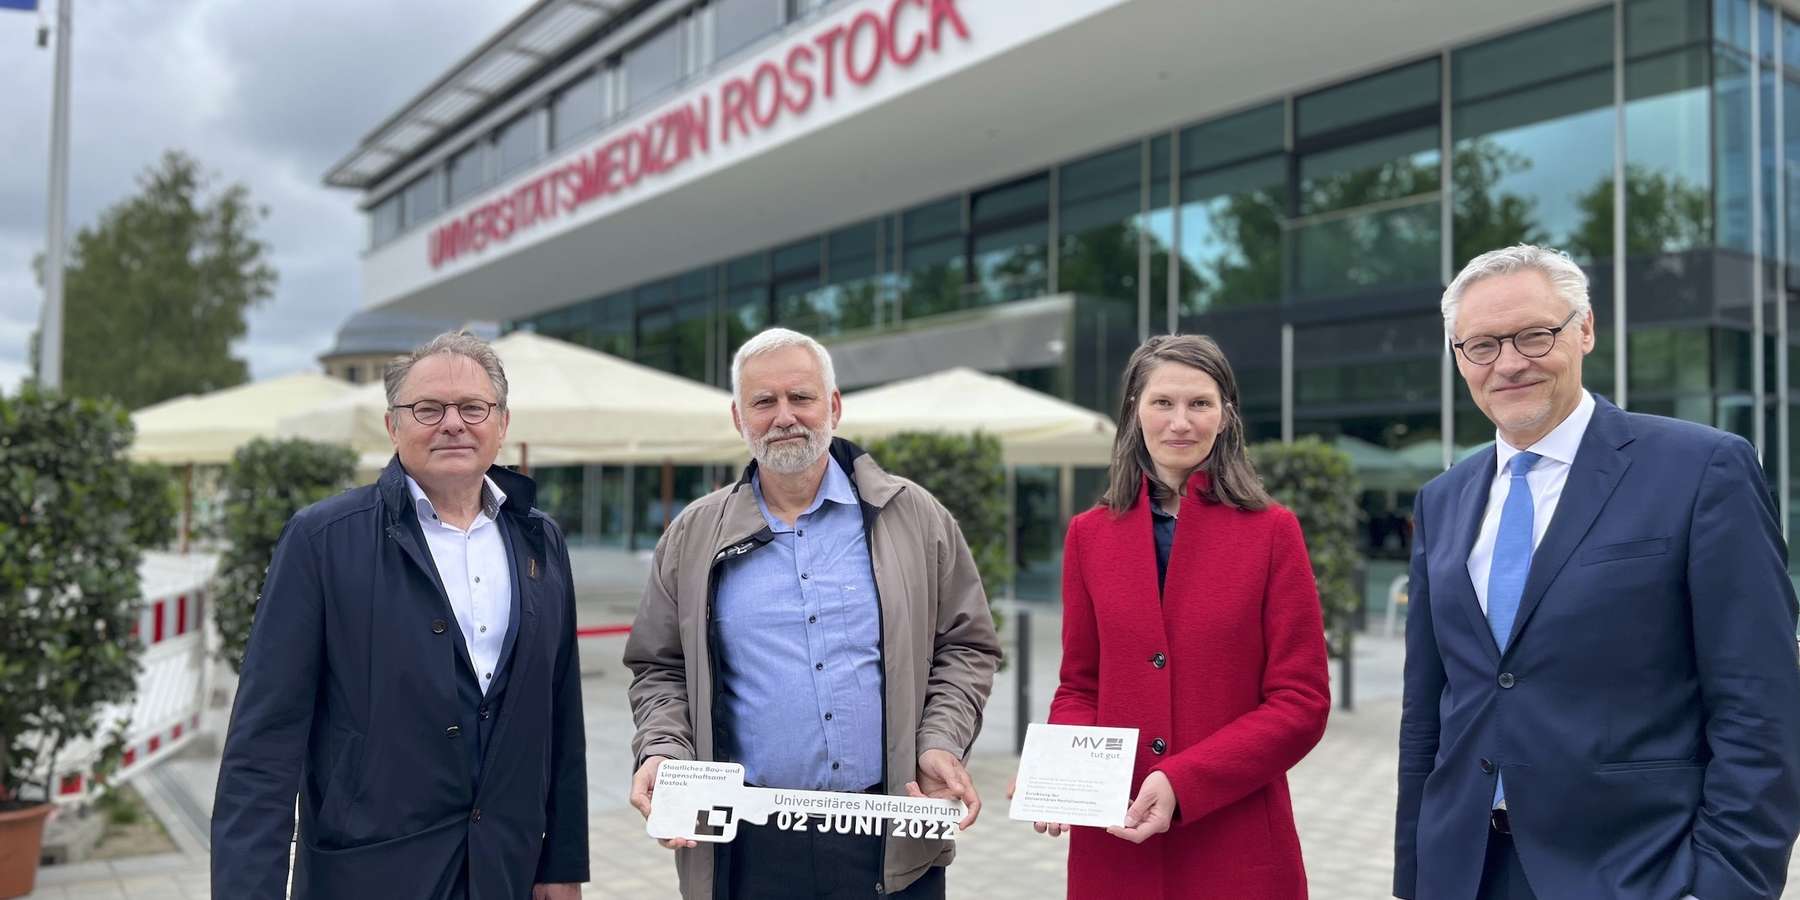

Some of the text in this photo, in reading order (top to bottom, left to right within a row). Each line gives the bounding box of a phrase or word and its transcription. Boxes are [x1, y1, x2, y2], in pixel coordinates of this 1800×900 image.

[720, 0, 970, 143] ROSTOCK
[1072, 736, 1104, 749] MV
[661, 772, 726, 780] Liegenschaftsamt
[774, 794, 961, 816] Universitäres Notfallzentrum
[777, 812, 954, 840] 02 JUNI 2022
